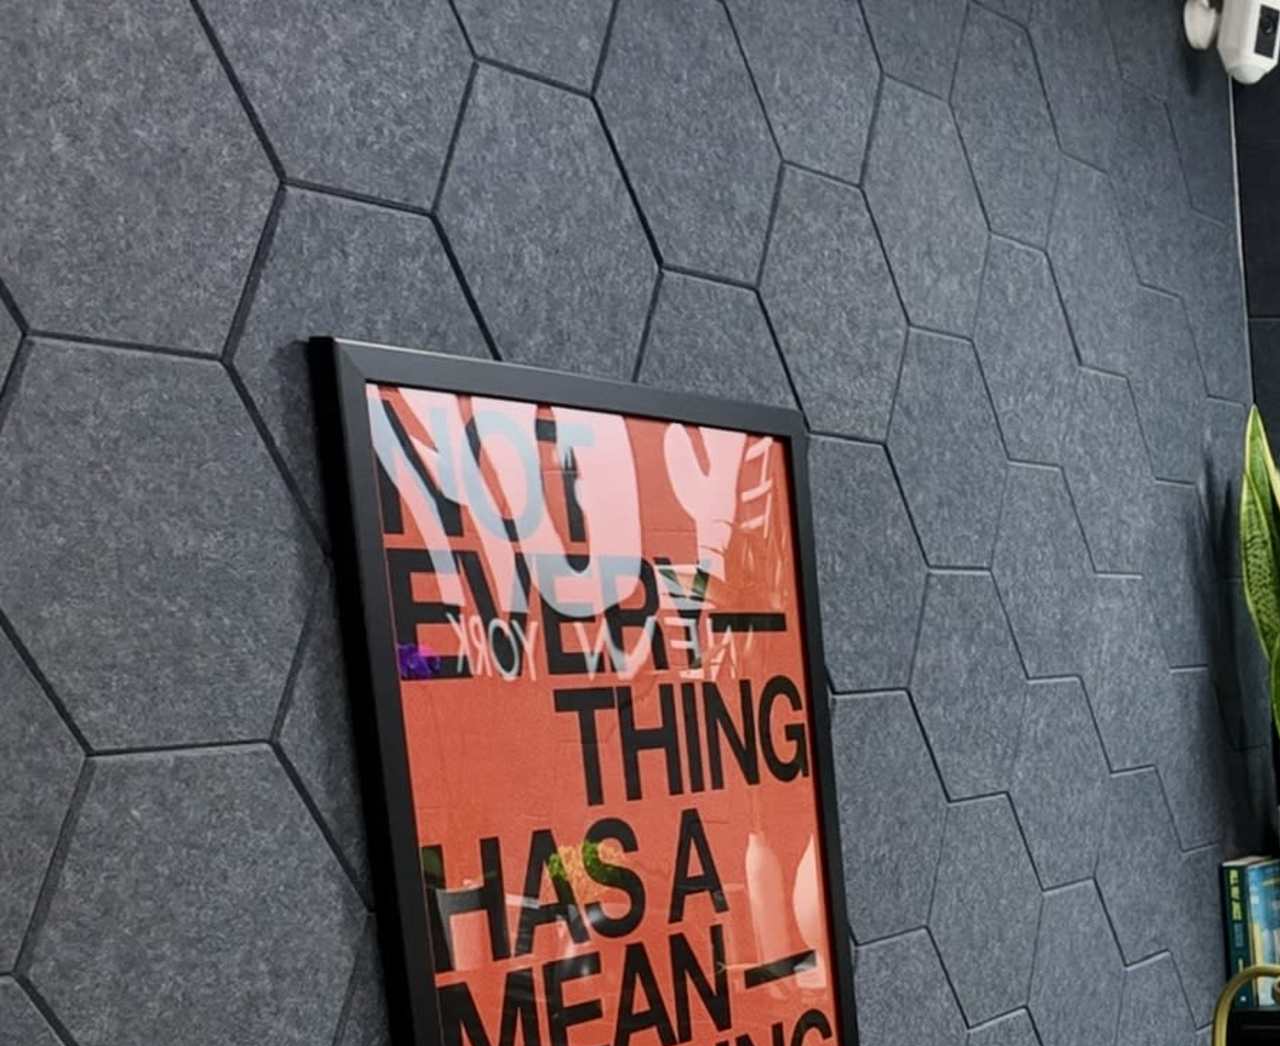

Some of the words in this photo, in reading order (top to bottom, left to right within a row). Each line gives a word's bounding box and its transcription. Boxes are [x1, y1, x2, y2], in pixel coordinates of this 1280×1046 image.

[368, 390, 597, 544] NOT
[553, 675, 811, 806] THING
[421, 817, 646, 974] HAS
[668, 808, 730, 925] A
